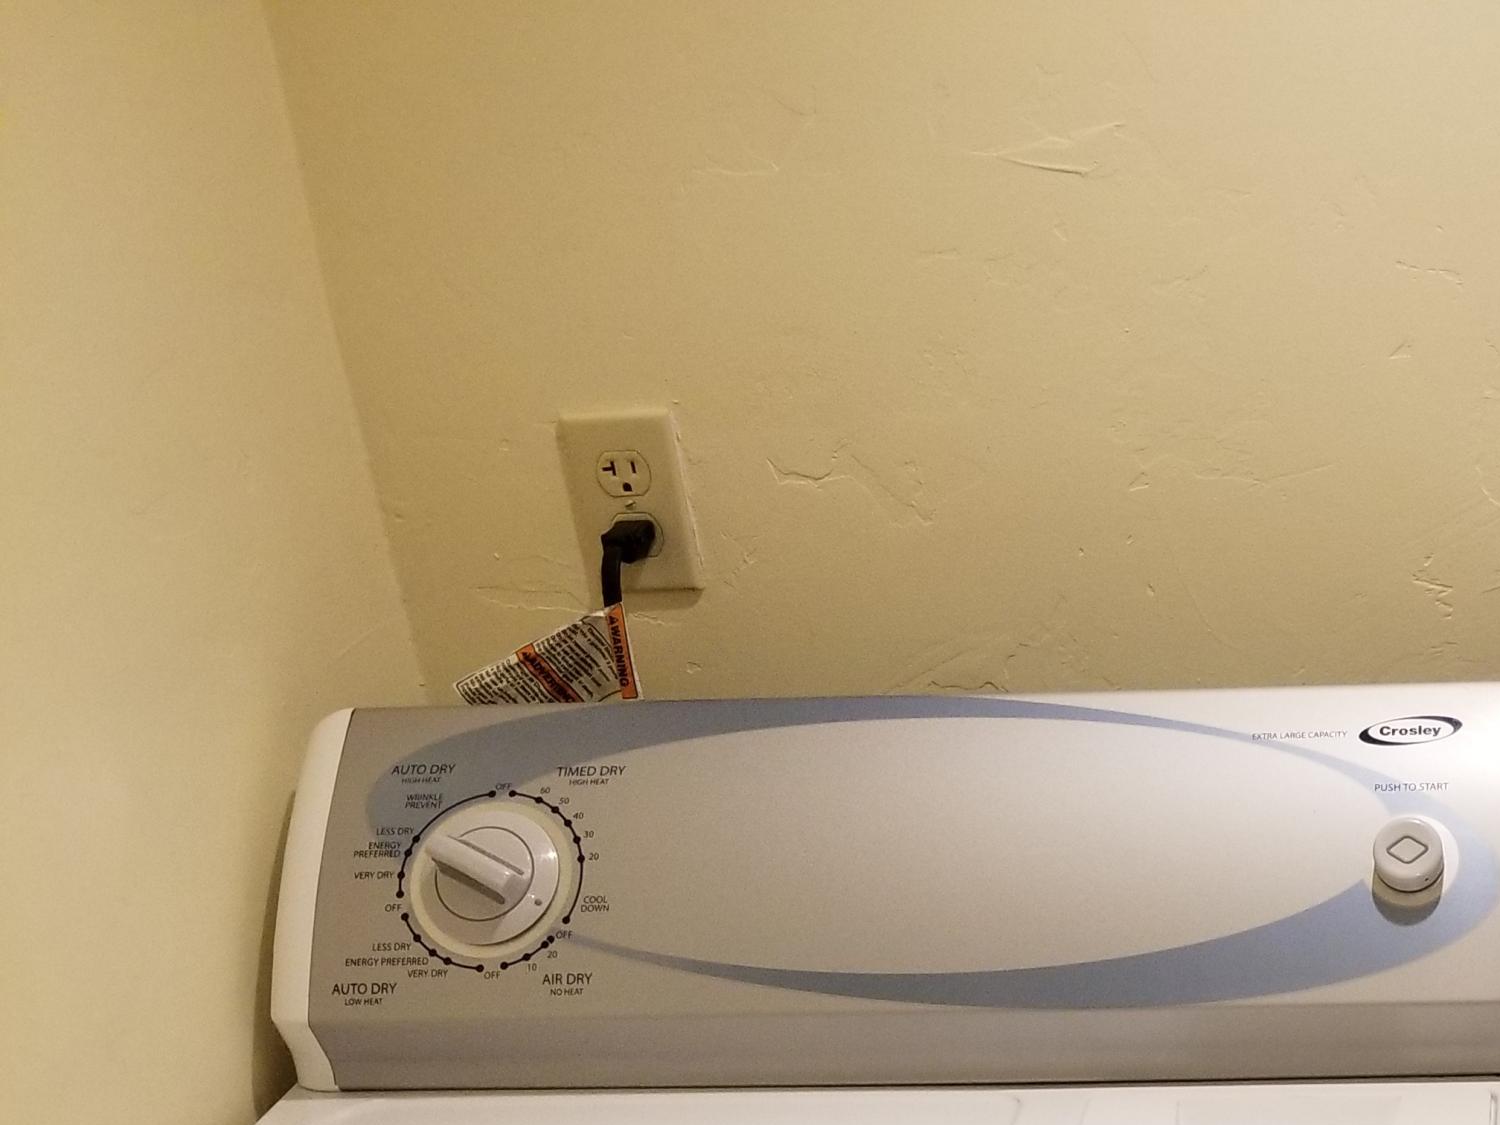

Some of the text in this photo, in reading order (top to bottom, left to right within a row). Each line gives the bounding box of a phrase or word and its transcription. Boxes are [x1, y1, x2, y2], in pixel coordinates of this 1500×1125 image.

[611, 626, 629, 687] WARNING
[1379, 725, 1441, 736] Crosley
[1252, 732, 1278, 740] EXTRA
[1280, 732, 1305, 740] LARGE
[391, 763, 456, 775] AUTO DRY
[557, 765, 626, 777] TIMED DRY
[1375, 784, 1400, 792] PUSH
[406, 794, 443, 802] WRINKLE
[573, 812, 584, 820] 40
[376, 827, 414, 836] LESS DRY
[368, 842, 401, 850] ENERGY
[353, 850, 400, 858] PREFERRED
[354, 871, 394, 880] VERY DRY
[584, 896, 607, 904] COOL
[384, 904, 402, 912] OFF
[581, 904, 609, 912] DOWN
[556, 930, 574, 939] OFF
[372, 942, 411, 951] LESS DRY
[345, 957, 429, 966] ENERGY PREFERRED
[528, 963, 537, 971] 10
[408, 969, 448, 978] VERY DRY
[484, 971, 501, 980] OFF
[542, 972, 592, 984] AIR DRY
[332, 982, 397, 995] AUTO DRY
[550, 988, 562, 996] NO
